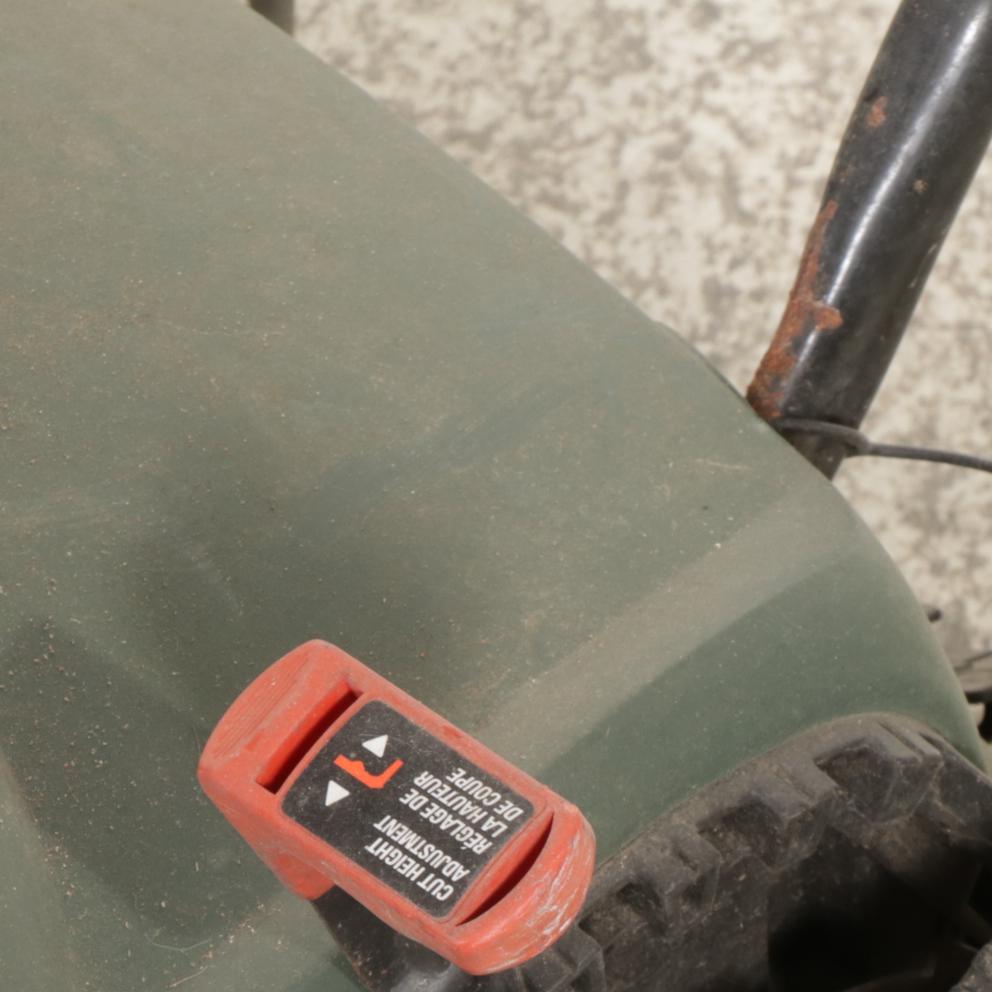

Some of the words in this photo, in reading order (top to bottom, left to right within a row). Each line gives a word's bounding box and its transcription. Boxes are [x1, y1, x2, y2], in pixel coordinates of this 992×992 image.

[398, 788, 429, 811] DE
[413, 770, 489, 824] HAUTEUR
[445, 767, 502, 806] COUPE
[419, 803, 493, 855] RÉGLAGE
[480, 815, 508, 838] LA
[493, 799, 525, 822] DE
[364, 837, 426, 882] HEIGHT
[373, 815, 471, 882] ADJUSTMENT
[416, 873, 454, 901] CUT
